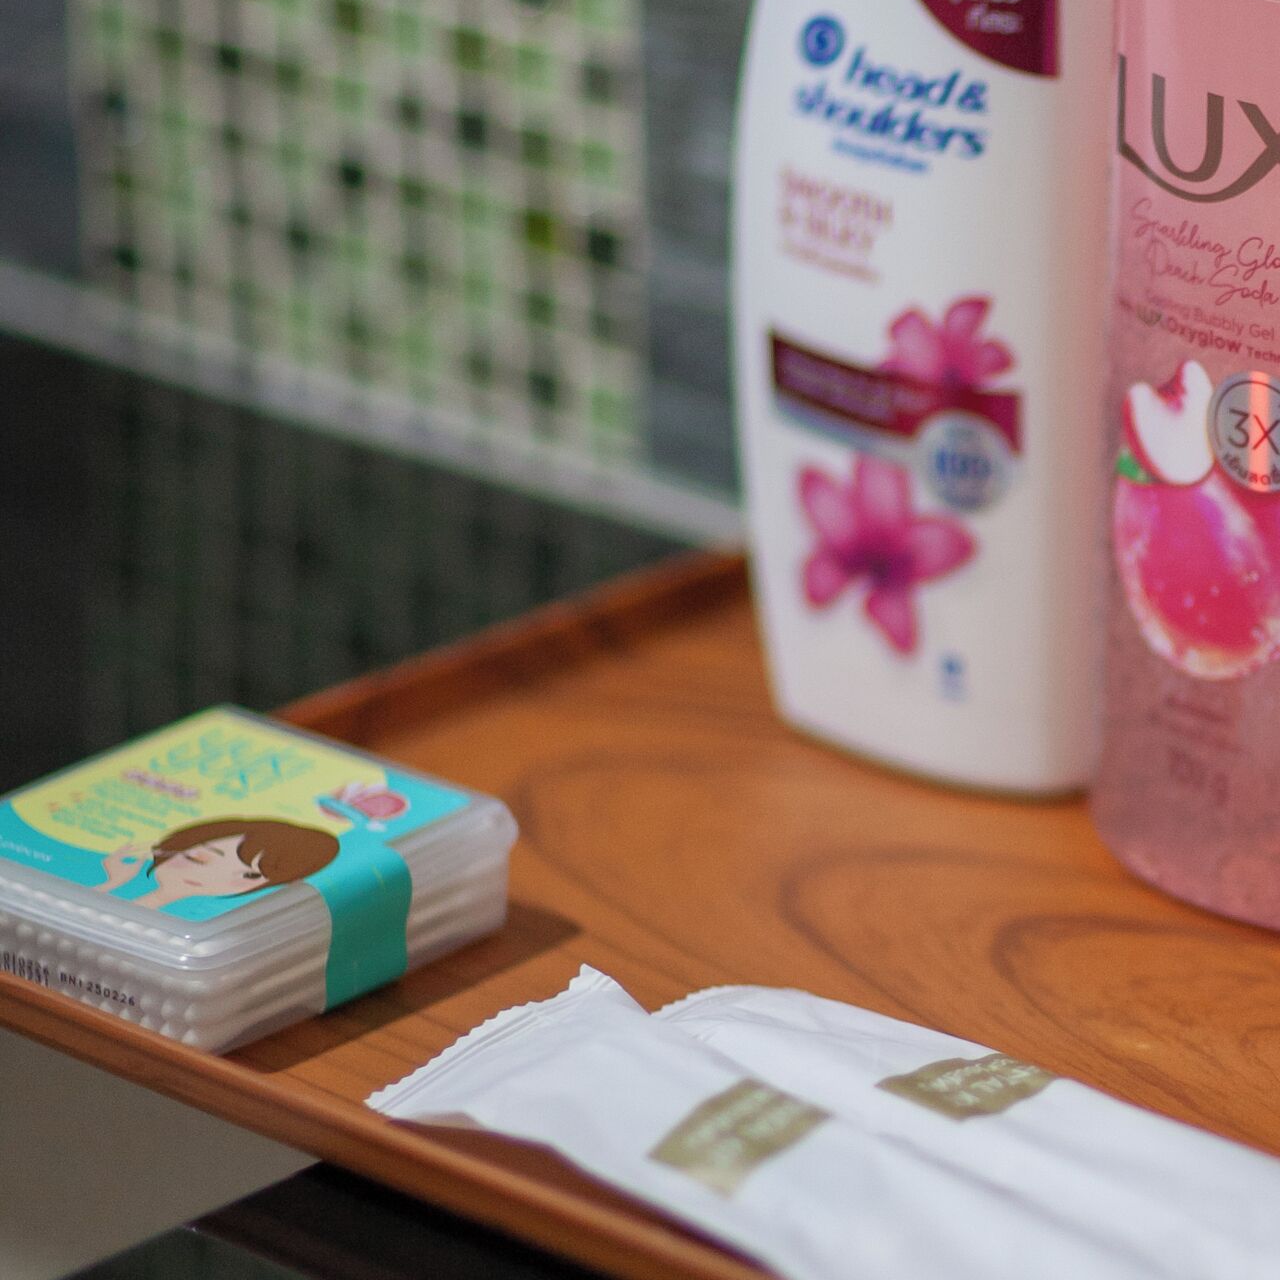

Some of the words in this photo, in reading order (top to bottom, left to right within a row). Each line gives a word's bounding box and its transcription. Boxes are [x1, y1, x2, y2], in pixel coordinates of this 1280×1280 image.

[796, 81, 986, 157] shoulders
[1131, 197, 1231, 268] Sparkling
[1208, 264, 1280, 308] Soda
[1166, 317, 1243, 355] Oxyglow
[1249, 323, 1275, 341] Gel
[1228, 407, 1280, 456] 3X
